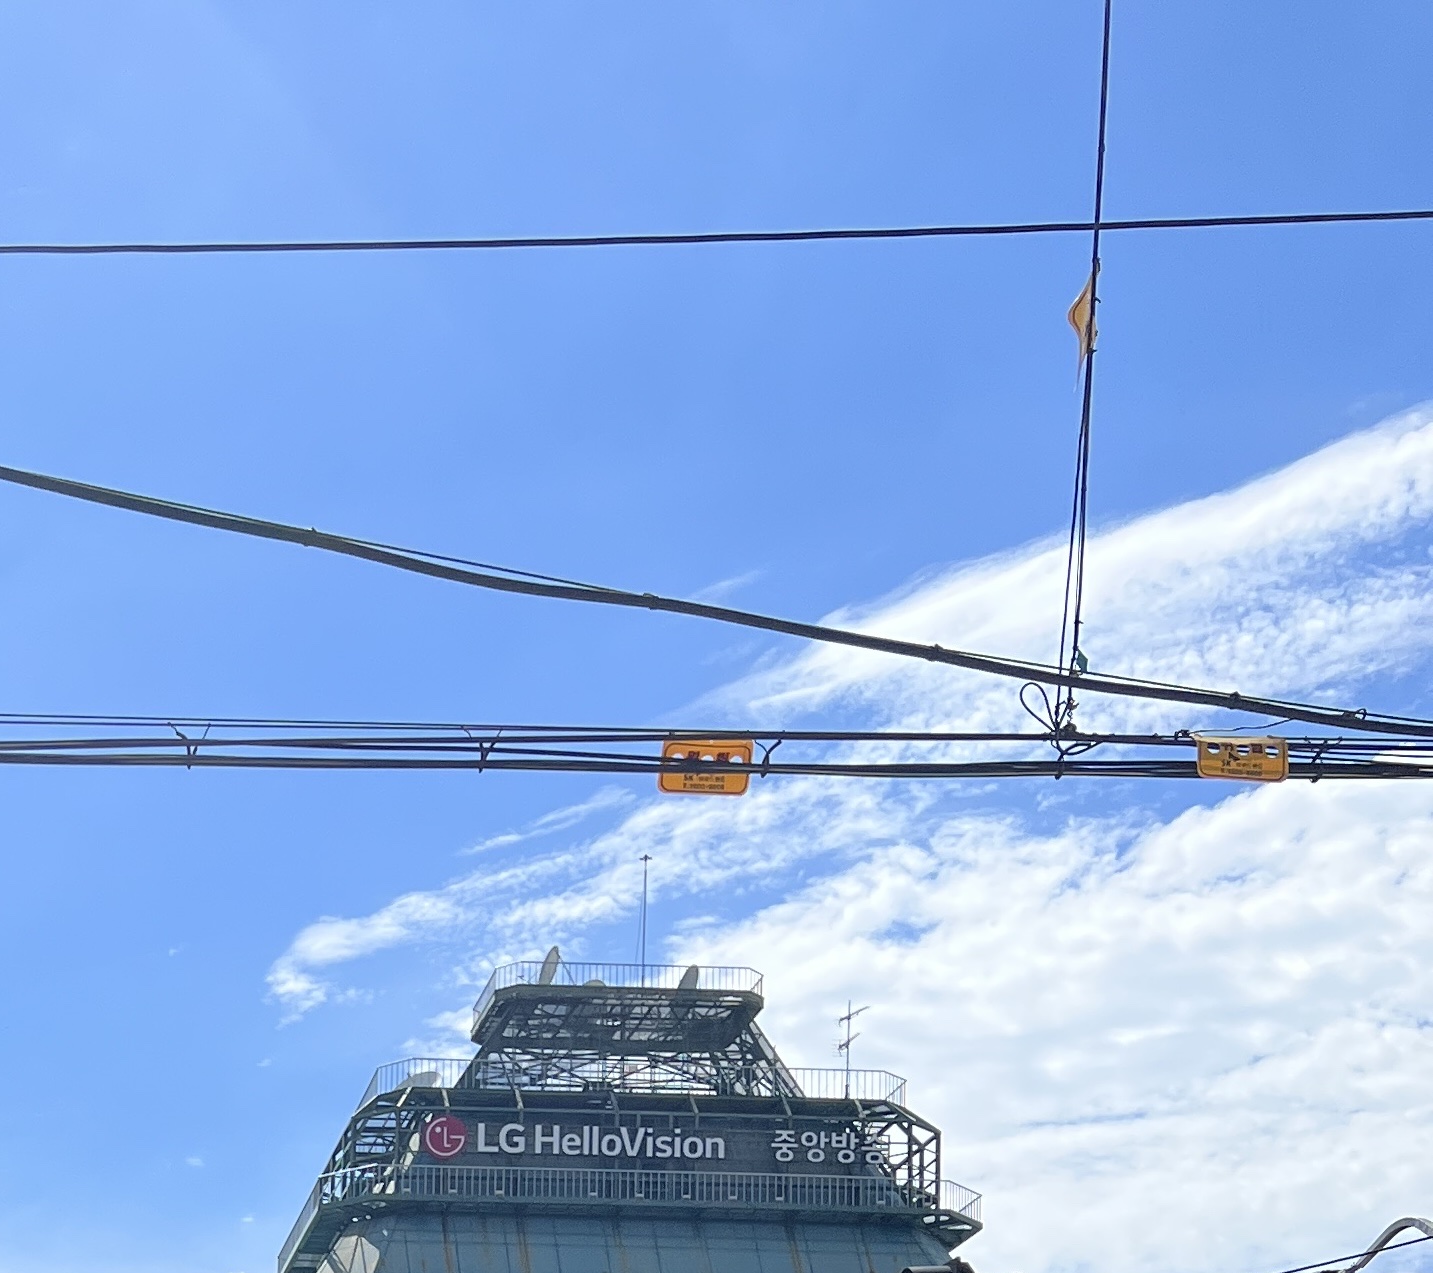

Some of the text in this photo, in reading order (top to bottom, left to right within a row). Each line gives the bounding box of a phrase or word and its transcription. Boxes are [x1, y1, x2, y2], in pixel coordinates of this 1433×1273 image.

[477, 1122, 726, 1160] LG HelloVision
[771, 1127, 890, 1166] 중앙방송
